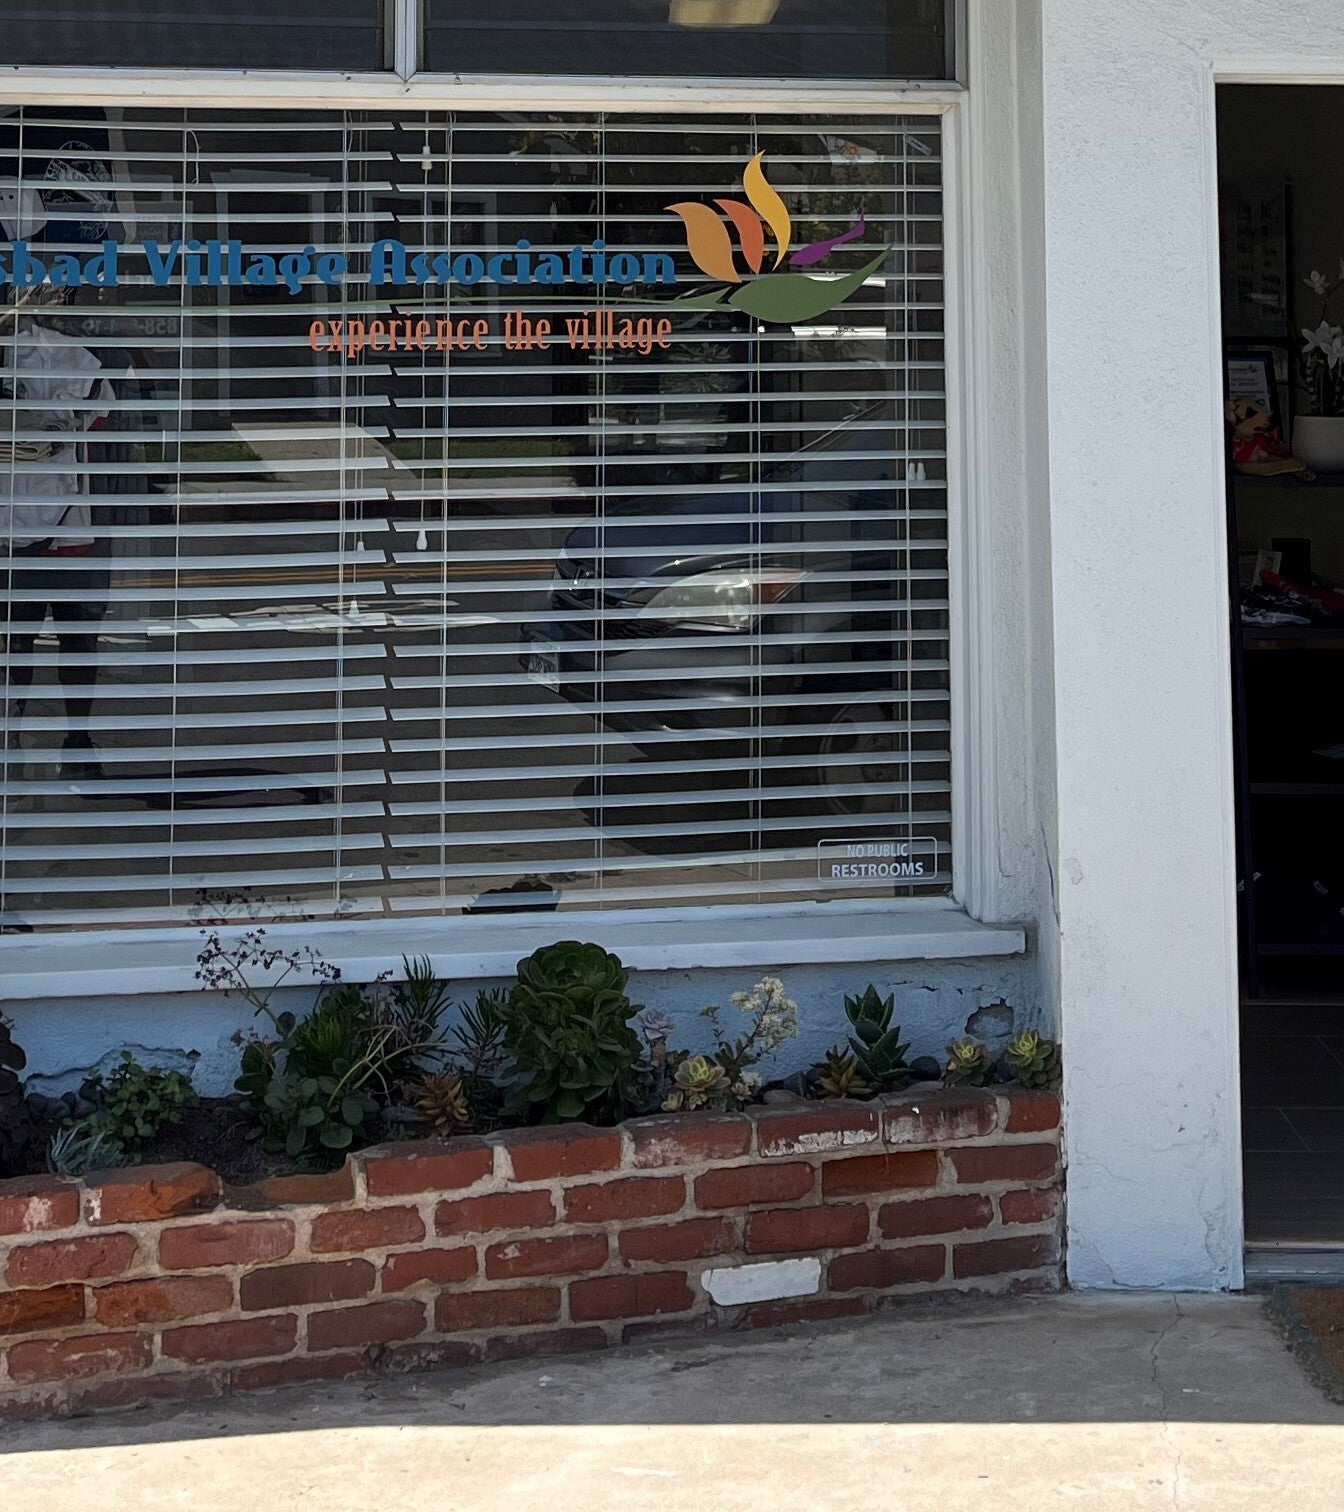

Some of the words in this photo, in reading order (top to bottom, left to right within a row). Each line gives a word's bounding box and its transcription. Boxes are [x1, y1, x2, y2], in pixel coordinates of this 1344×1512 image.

[141, 240, 347, 295] Village
[368, 239, 677, 286] Association
[309, 311, 490, 359] experience
[504, 310, 551, 352] the
[565, 311, 673, 355] village
[846, 845, 864, 858] NO
[867, 844, 908, 858] PUBLIC
[831, 862, 924, 878] RESTROOMS
